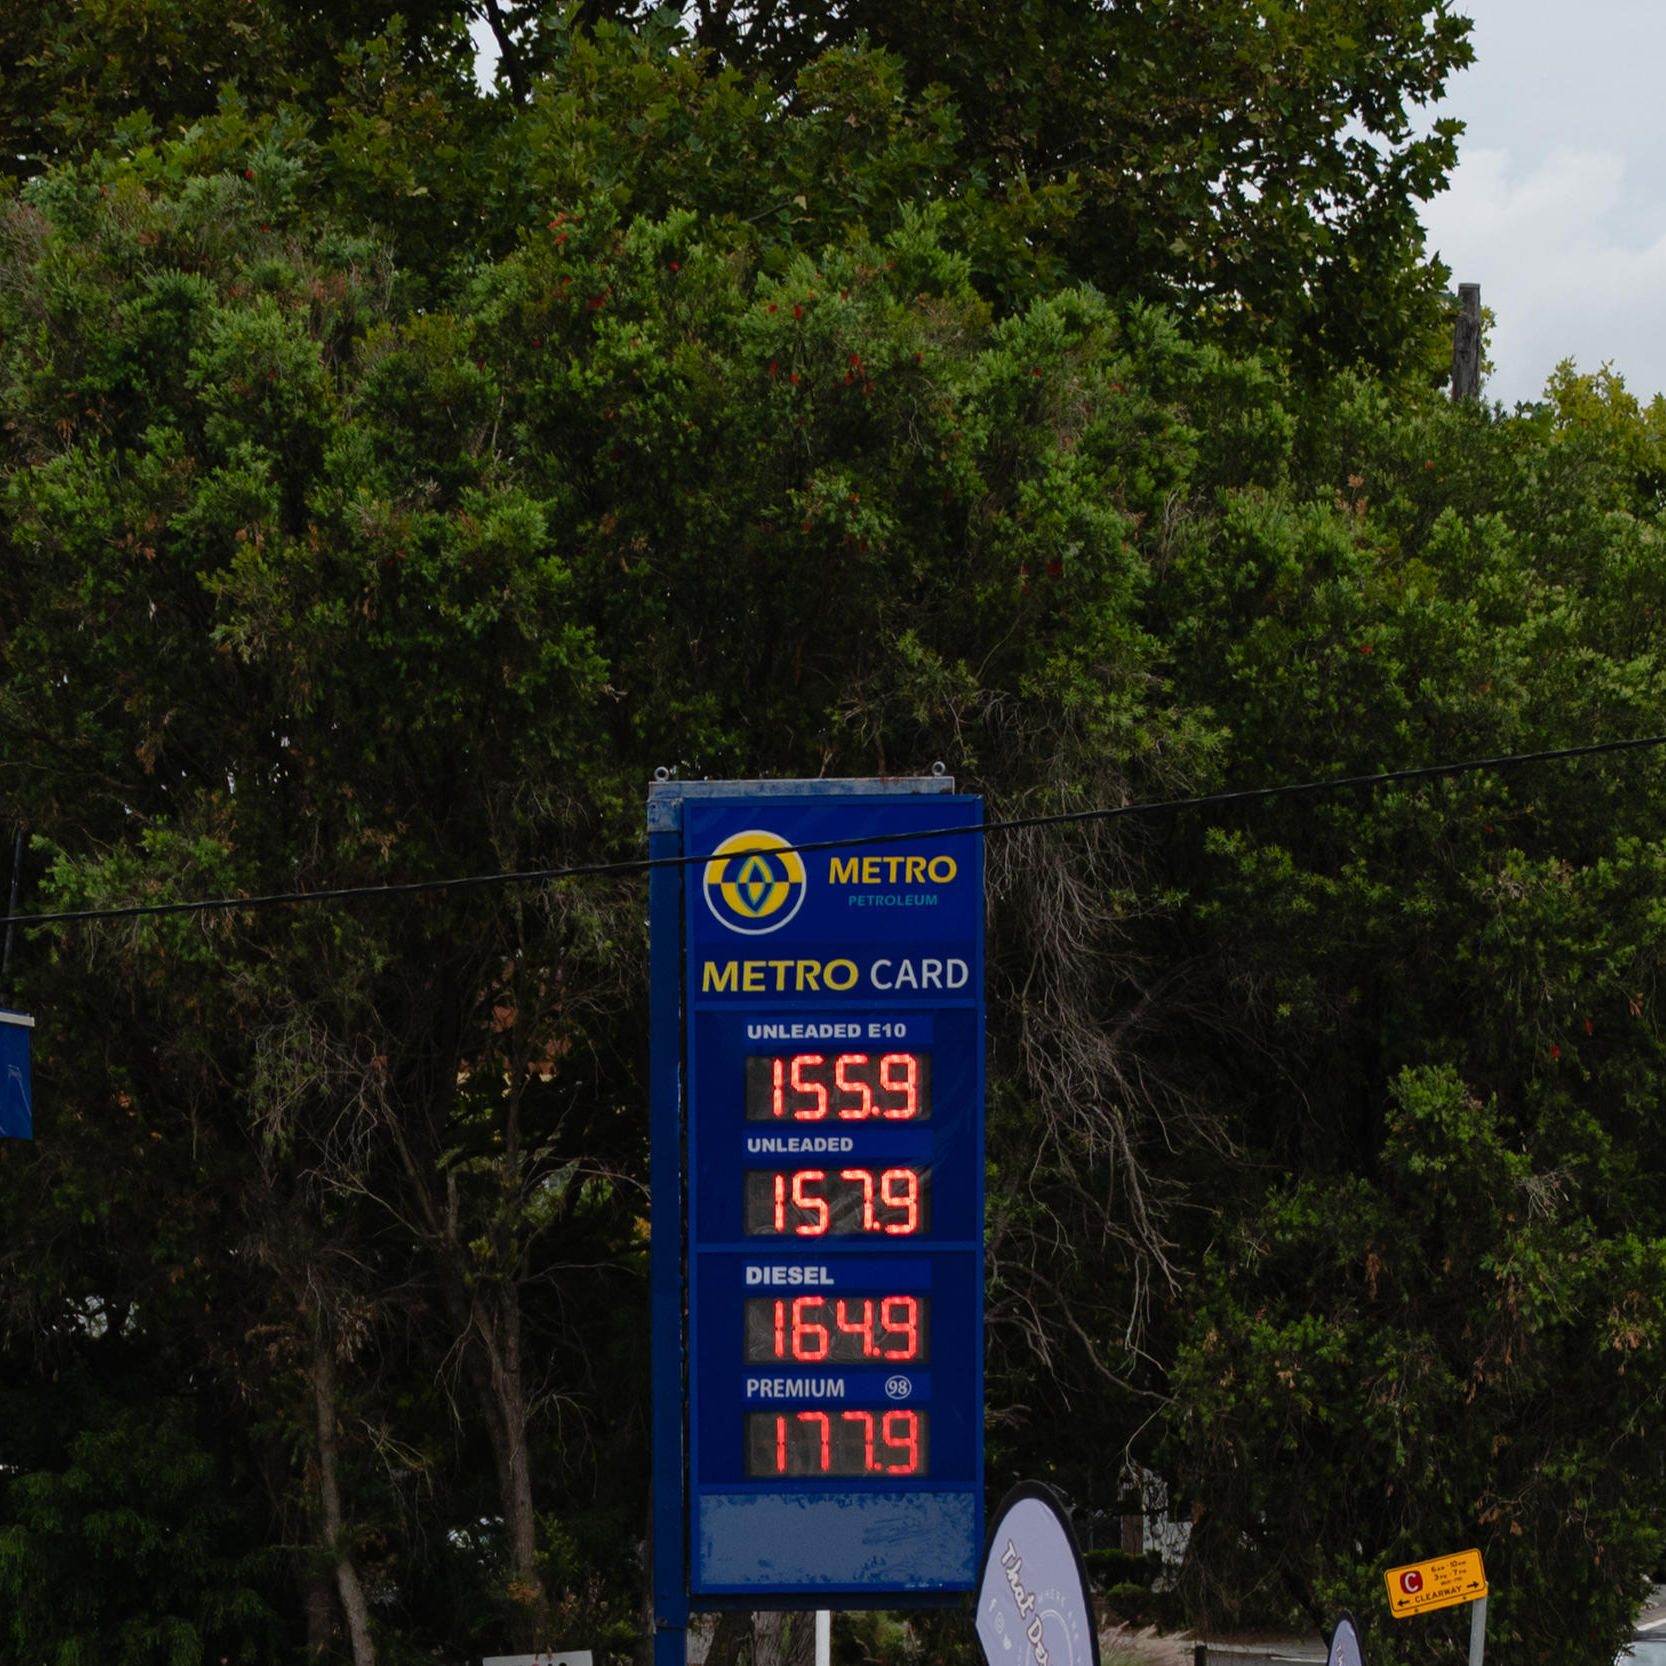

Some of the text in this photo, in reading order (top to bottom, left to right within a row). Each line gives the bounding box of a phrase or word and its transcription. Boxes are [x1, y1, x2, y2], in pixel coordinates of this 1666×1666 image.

[828, 855, 958, 885] METRO
[848, 894, 938, 907] PETROLEUM
[702, 958, 969, 993] METRO CARD
[747, 1023, 907, 1039] UNLEADED E10
[772, 1053, 918, 1121] 155.9
[747, 1137, 854, 1152] UNLEADED
[773, 1168, 919, 1235] 157.9
[746, 1265, 834, 1286] DIESEL
[773, 1295, 918, 1360] 164.9
[746, 1379, 909, 1399] PREMIUM 98
[775, 1410, 919, 1475] 177.9
[1001, 1539, 1035, 1619] That
[1405, 1573, 1419, 1593] C
[1415, 1585, 1461, 1603] CLEARWAY
